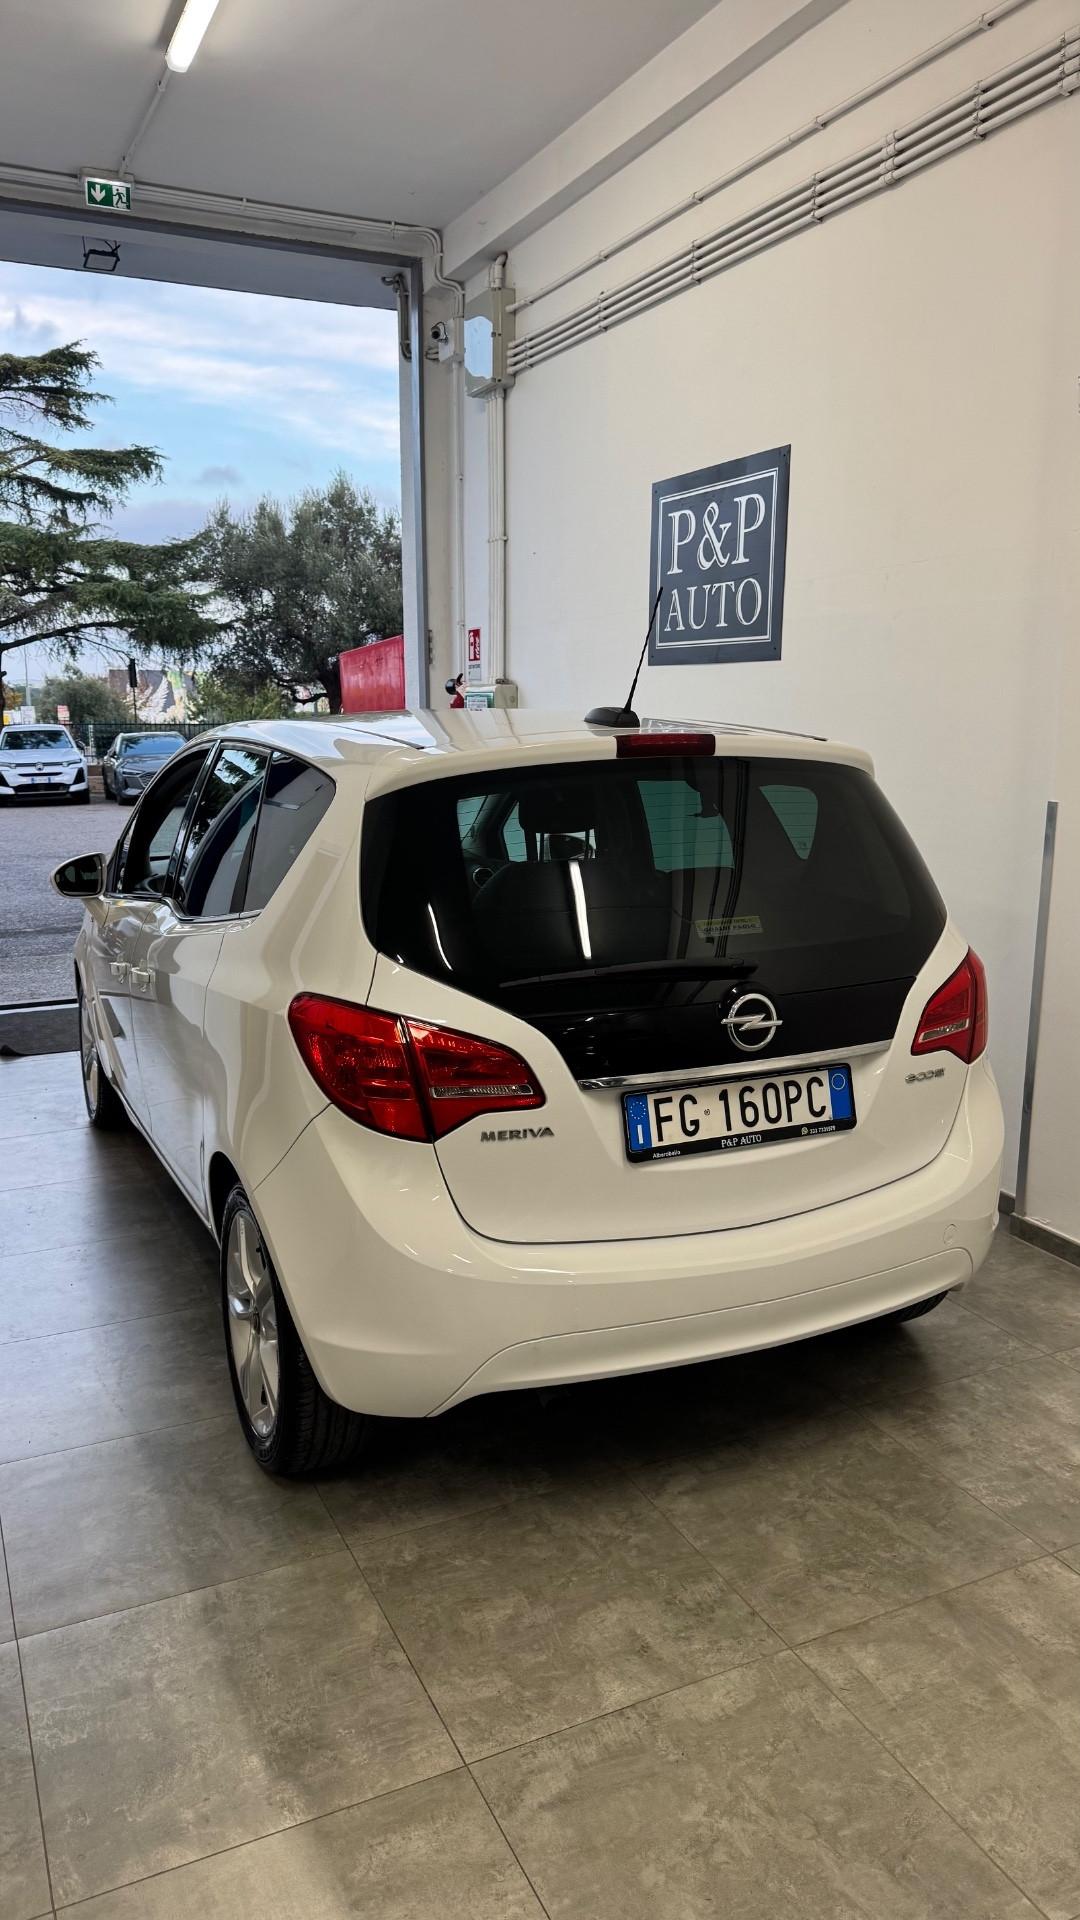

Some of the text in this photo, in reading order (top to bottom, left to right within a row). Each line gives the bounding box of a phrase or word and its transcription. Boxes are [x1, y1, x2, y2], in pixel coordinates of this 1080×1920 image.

[667, 493, 766, 576] P&P
[664, 577, 762, 632] AUTO
[480, 1126, 555, 1142] MERIVA
[653, 1076, 826, 1143] FG 160PC
[721, 1134, 762, 1149] P&P AUTO
